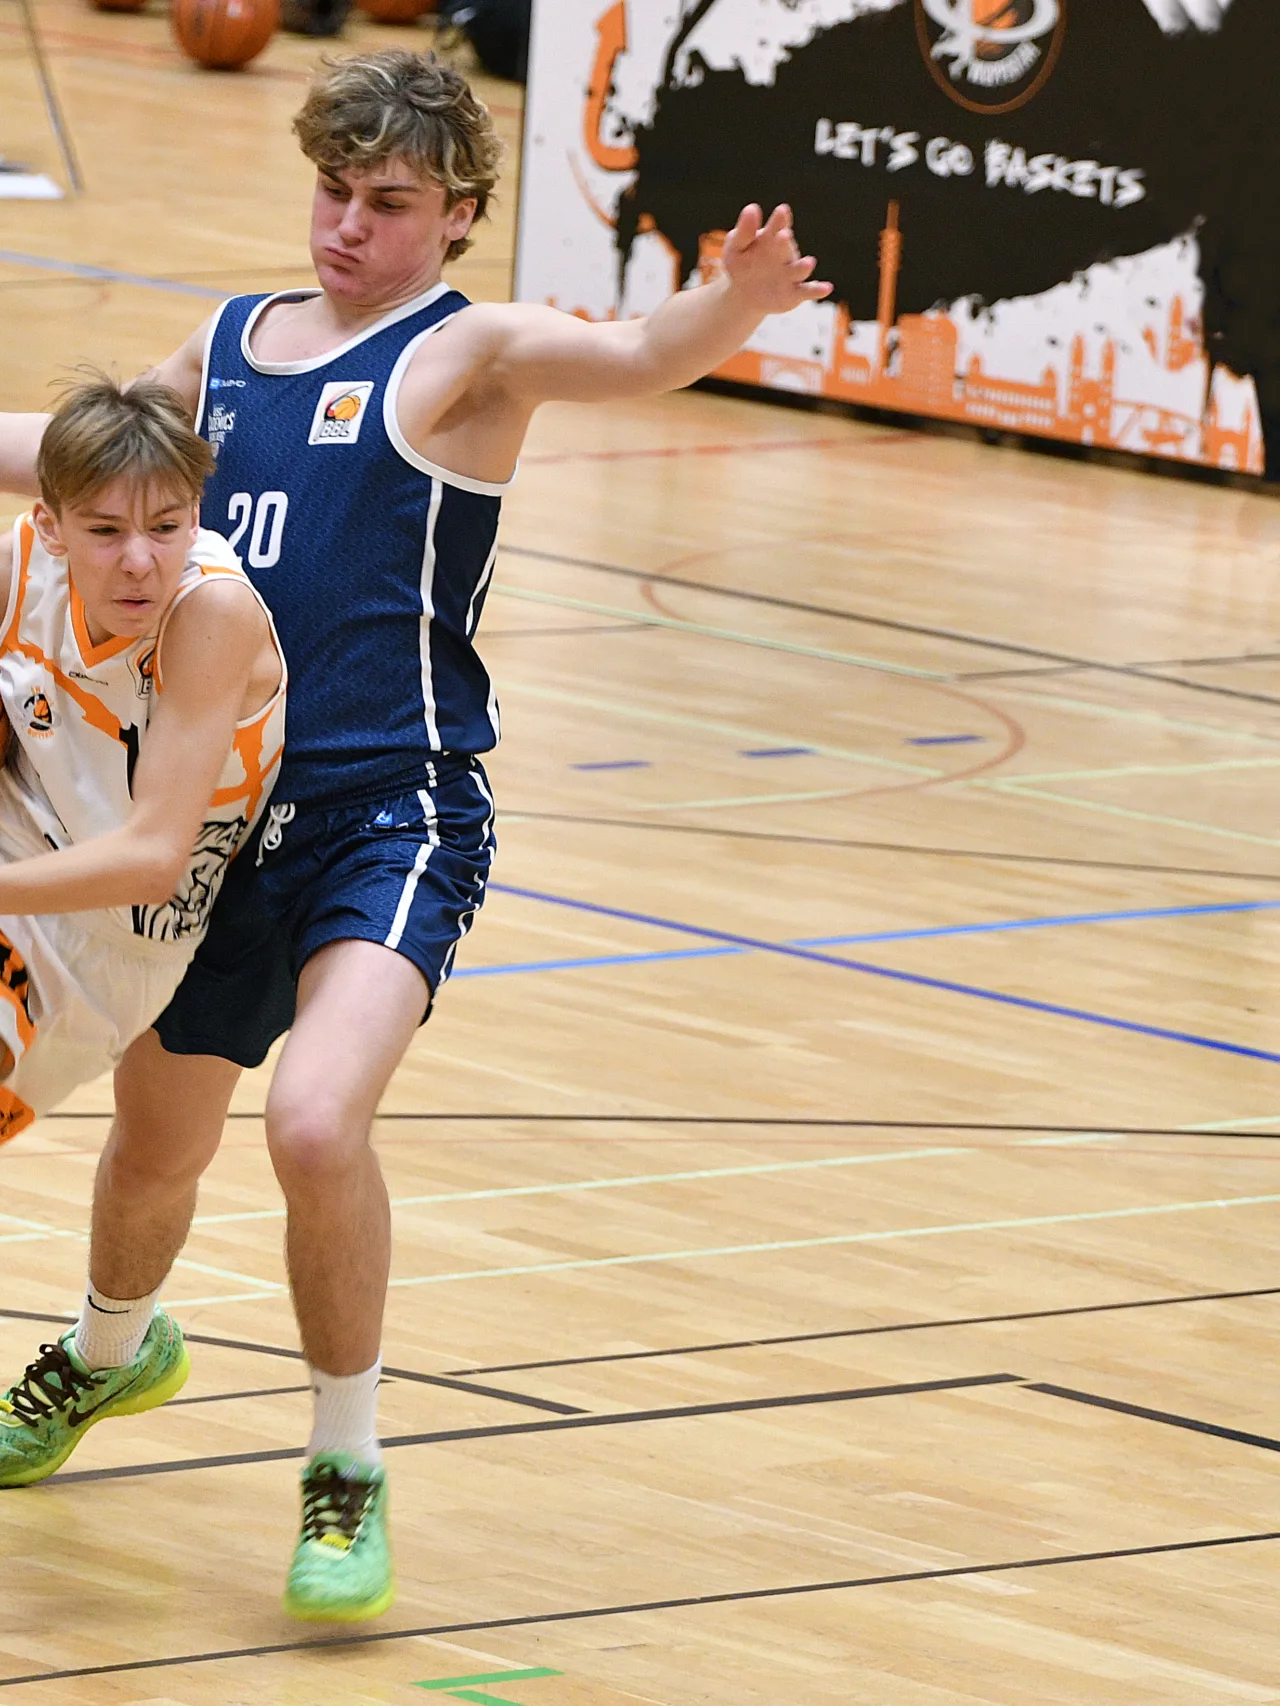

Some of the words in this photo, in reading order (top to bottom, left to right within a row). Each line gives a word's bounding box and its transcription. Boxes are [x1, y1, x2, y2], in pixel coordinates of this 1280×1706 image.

[815, 117, 920, 173] LET'S
[925, 136, 975, 178] GO
[983, 138, 1147, 208] BASKETS
[226, 490, 289, 569] 20
